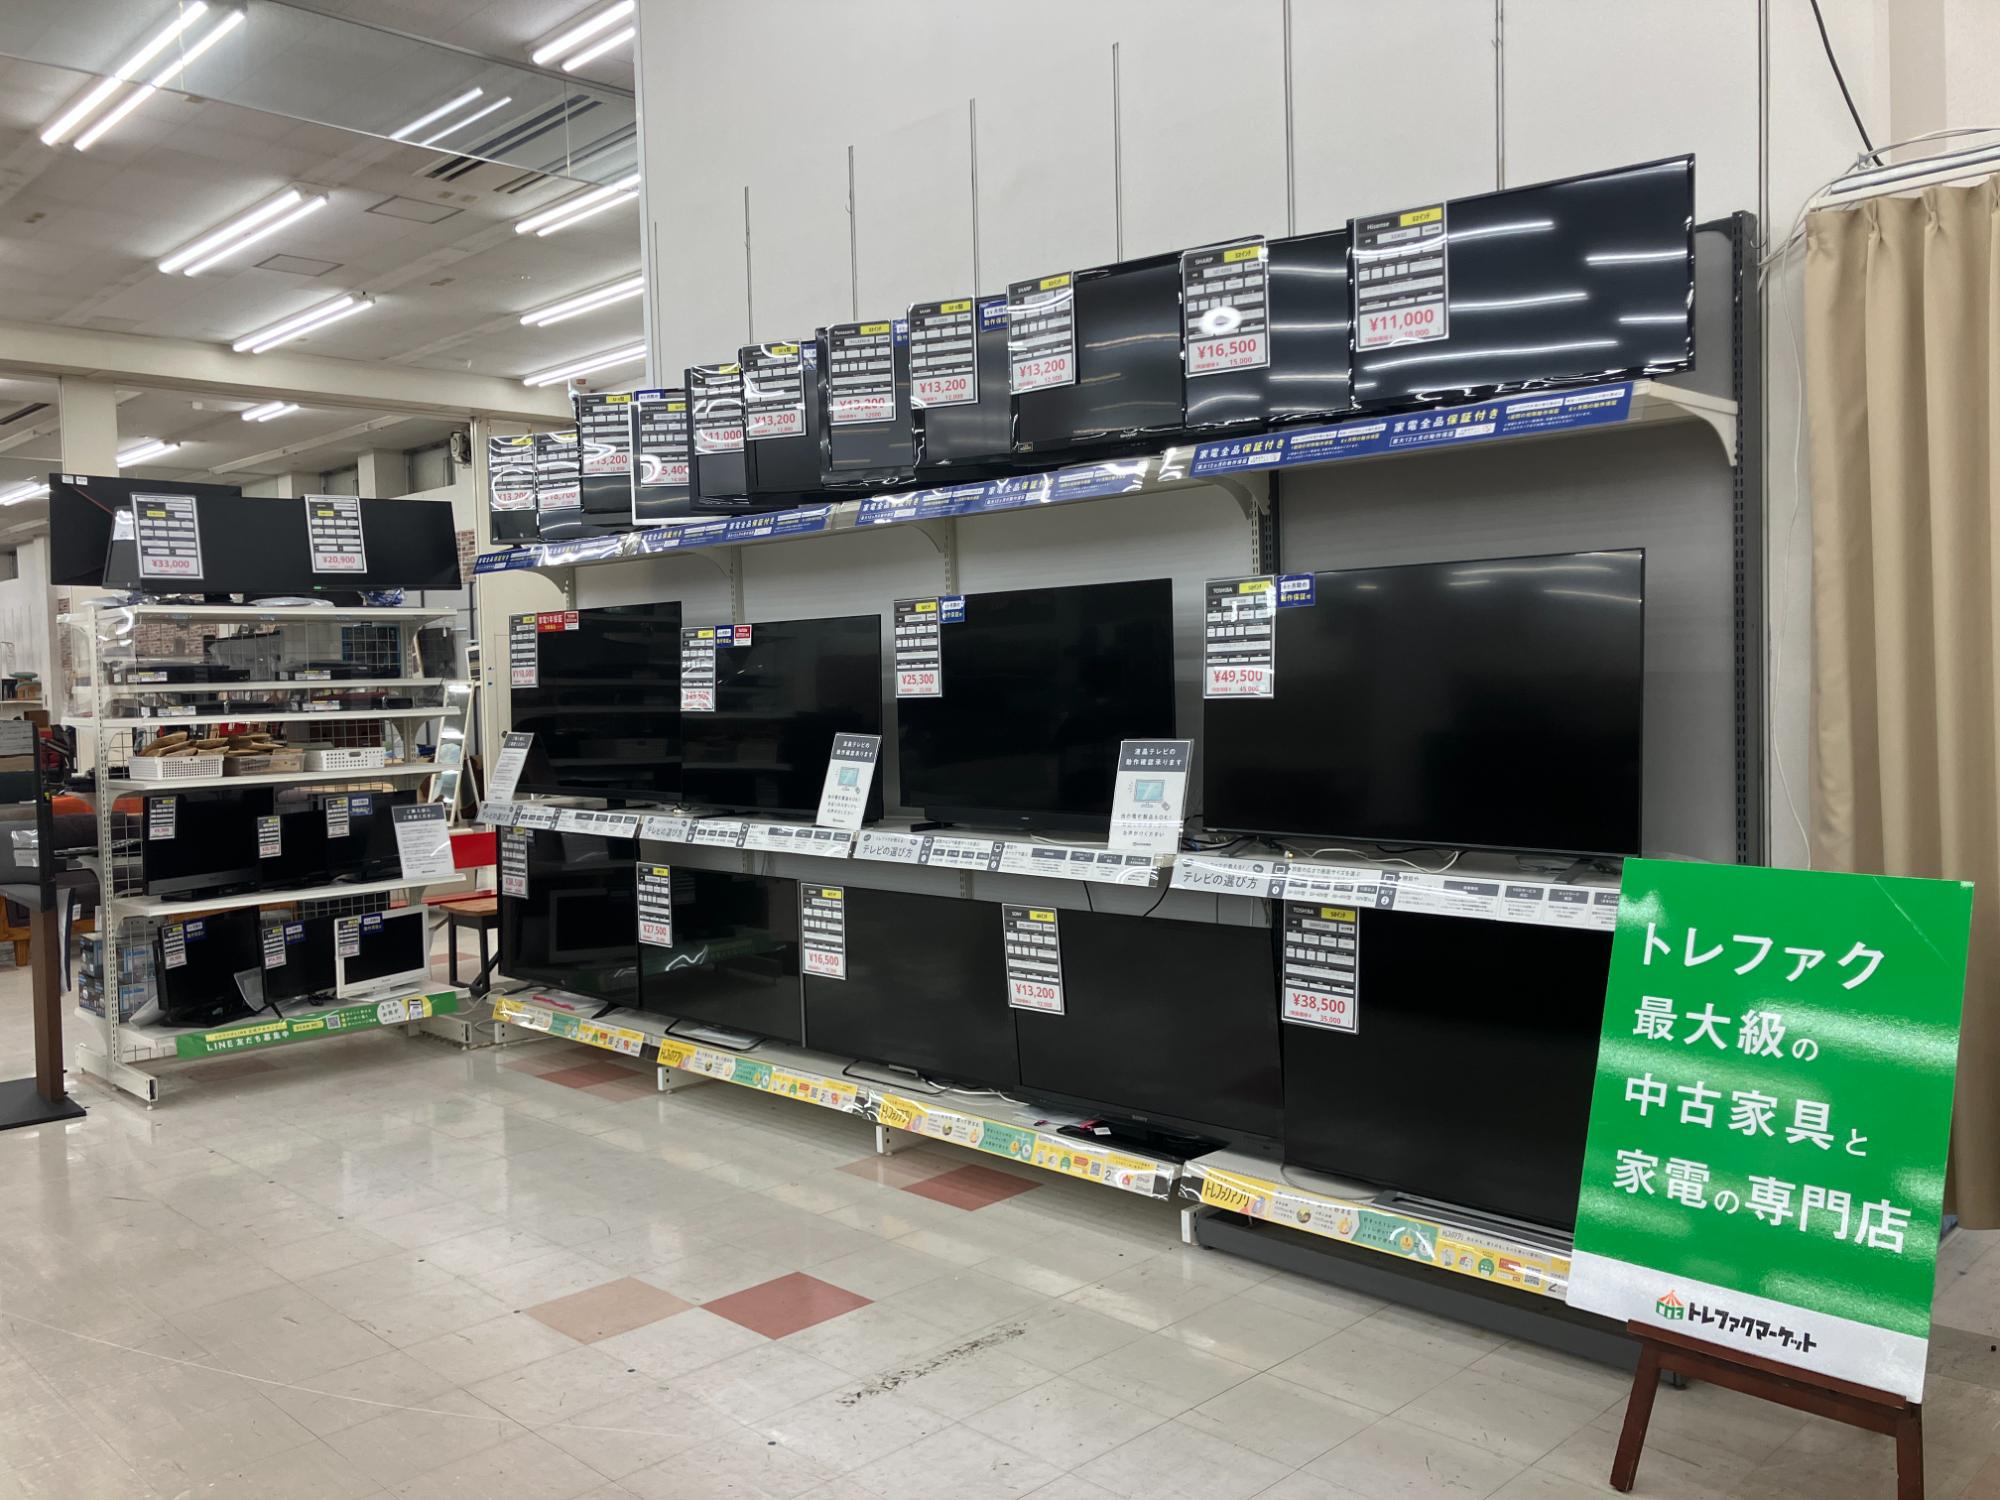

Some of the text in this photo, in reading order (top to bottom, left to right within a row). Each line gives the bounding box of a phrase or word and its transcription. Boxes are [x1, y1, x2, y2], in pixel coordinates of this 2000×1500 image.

[1369, 309, 1434, 332] ¥11,000
[1197, 339, 1256, 359] ¥16,500
[1019, 358, 1066, 378] ¥13,200
[919, 378, 966, 393] ¥13,200
[754, 413, 796, 426] ¥13,200
[1394, 408, 1499, 433] 家電全品保証付き
[1199, 439, 1285, 459] 家電全品保証付き
[590, 454, 628, 465] 13,200
[152, 559, 190, 568] ¥33,000
[901, 674, 934, 685] ¥25,300
[1214, 670, 1263, 684] ¥49,500
[863, 845, 913, 858] テレビの選び方
[1183, 872, 1258, 889] テレビの選び方
[1293, 906, 1314, 915] TOSHIBA
[809, 953, 839, 967] ¥16,500
[1641, 922, 1885, 990] トレファク
[1016, 984, 1055, 999] ¥13,200
[1293, 993, 1345, 1014] ¥38,500
[1320, 1015, 1341, 1024] 35,000
[1632, 995, 1819, 1063] 最大級の
[206, 1030, 290, 1051] LINE 友だち募集中
[1624, 1072, 1869, 1157] 中古家具と
[1104, 1170, 1112, 1181] 2
[1612, 1149, 1912, 1254] 家電の専門店
[1688, 1302, 1817, 1353] トレファクマーケット
